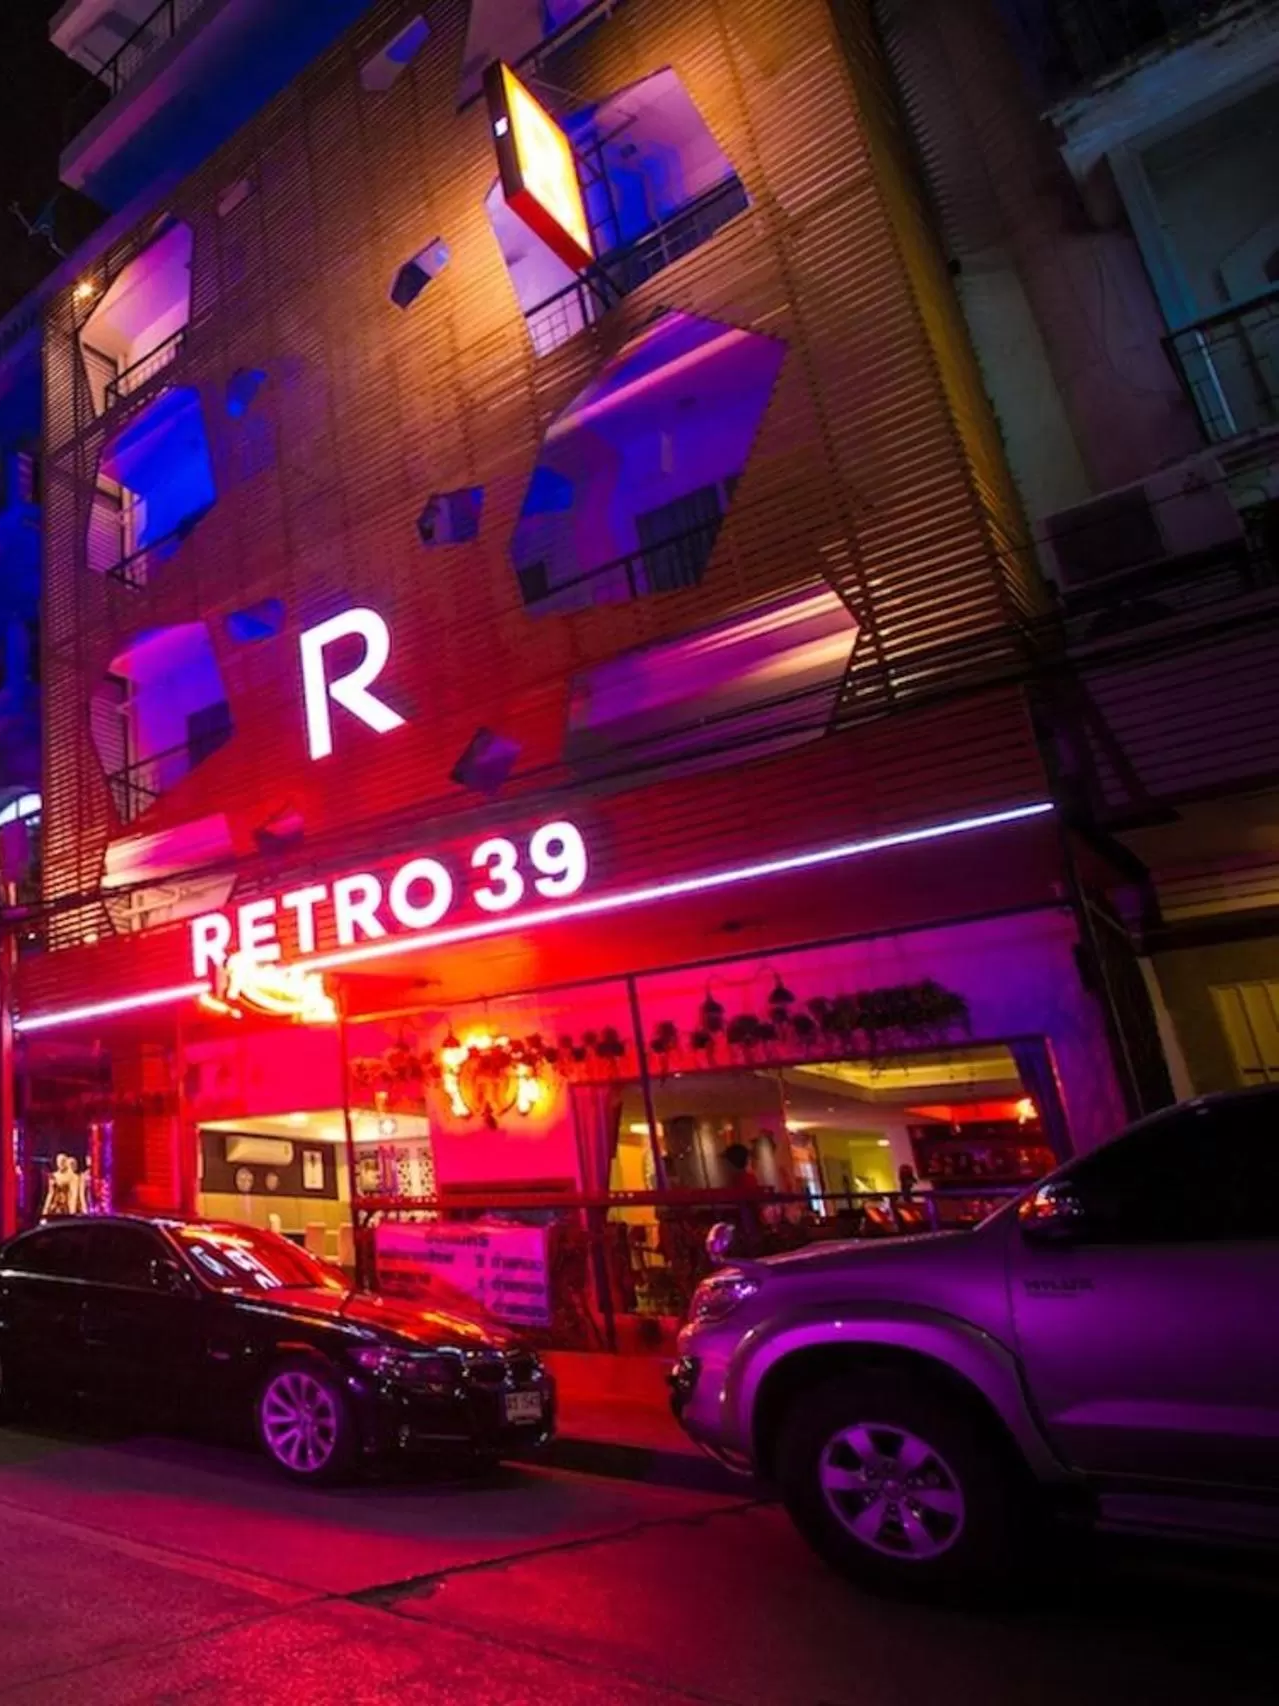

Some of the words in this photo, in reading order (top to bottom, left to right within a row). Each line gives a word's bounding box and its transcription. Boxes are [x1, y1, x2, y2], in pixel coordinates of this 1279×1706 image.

[299, 607, 406, 761] R
[191, 857, 453, 977] RETRO
[472, 821, 588, 911] 39
